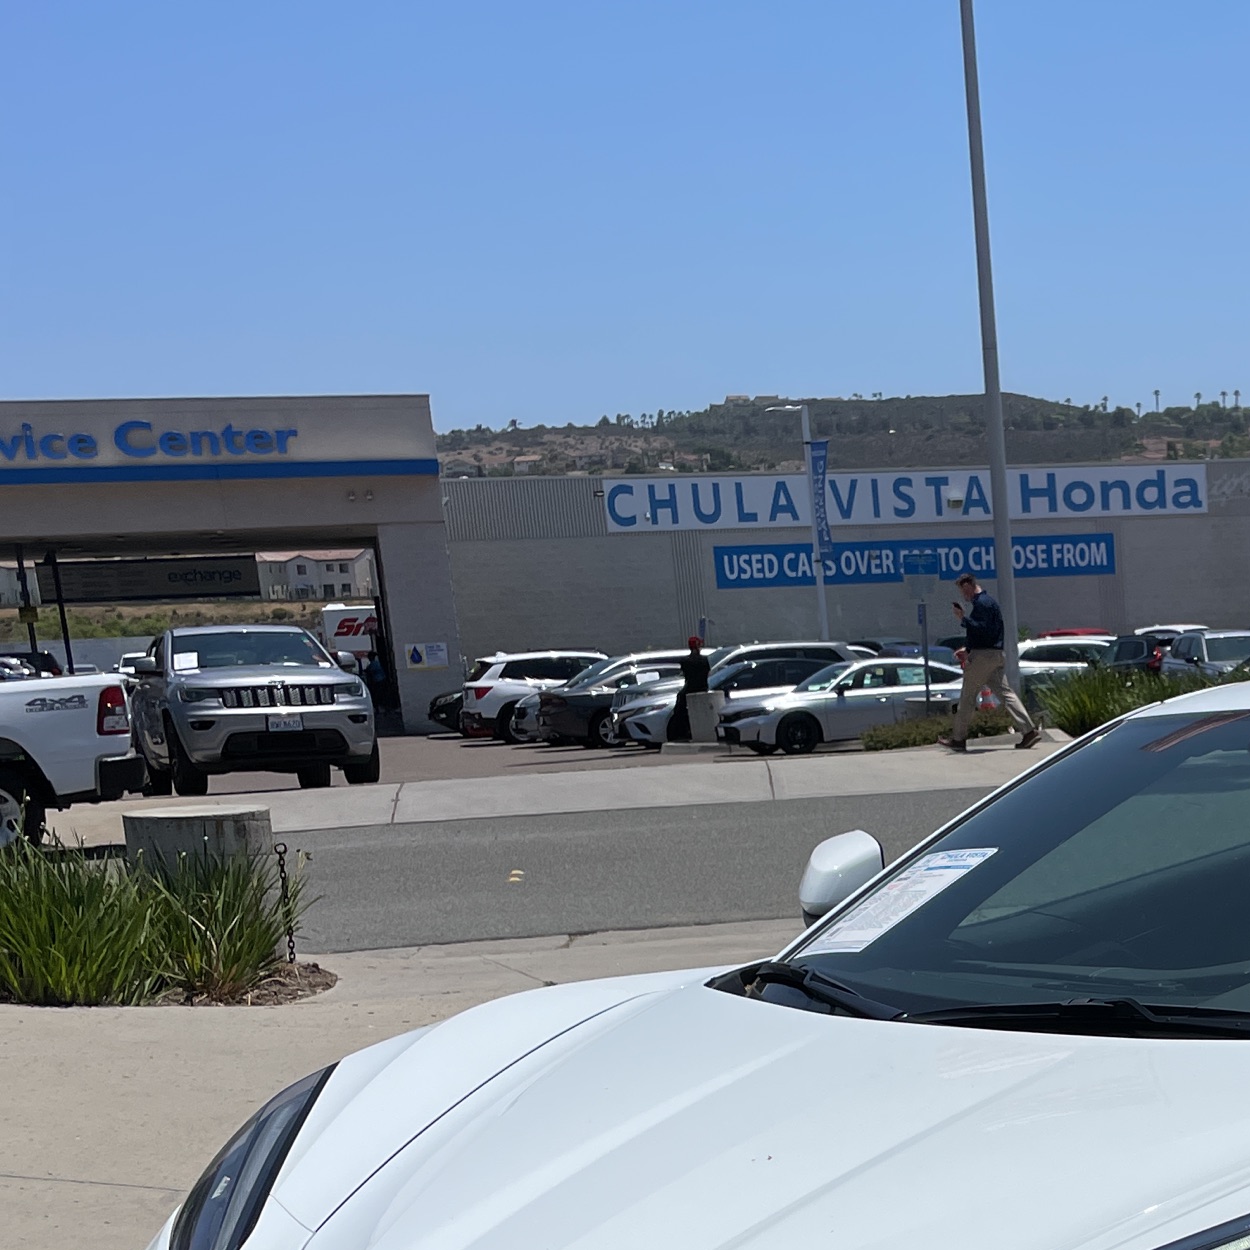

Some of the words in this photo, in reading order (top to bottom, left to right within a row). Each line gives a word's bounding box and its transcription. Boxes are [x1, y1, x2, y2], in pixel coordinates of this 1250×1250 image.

[113, 420, 299, 459] Center
[607, 480, 800, 527] CHULA
[829, 476, 991, 519] VISTA
[1019, 469, 1203, 514] Honda
[723, 552, 779, 580] USED
[840, 549, 896, 575] OVER
[937, 546, 965, 572] TO
[968, 544, 1048, 571] CHOSE
[1052, 541, 1109, 567] FROM
[168, 568, 242, 585] exchange
